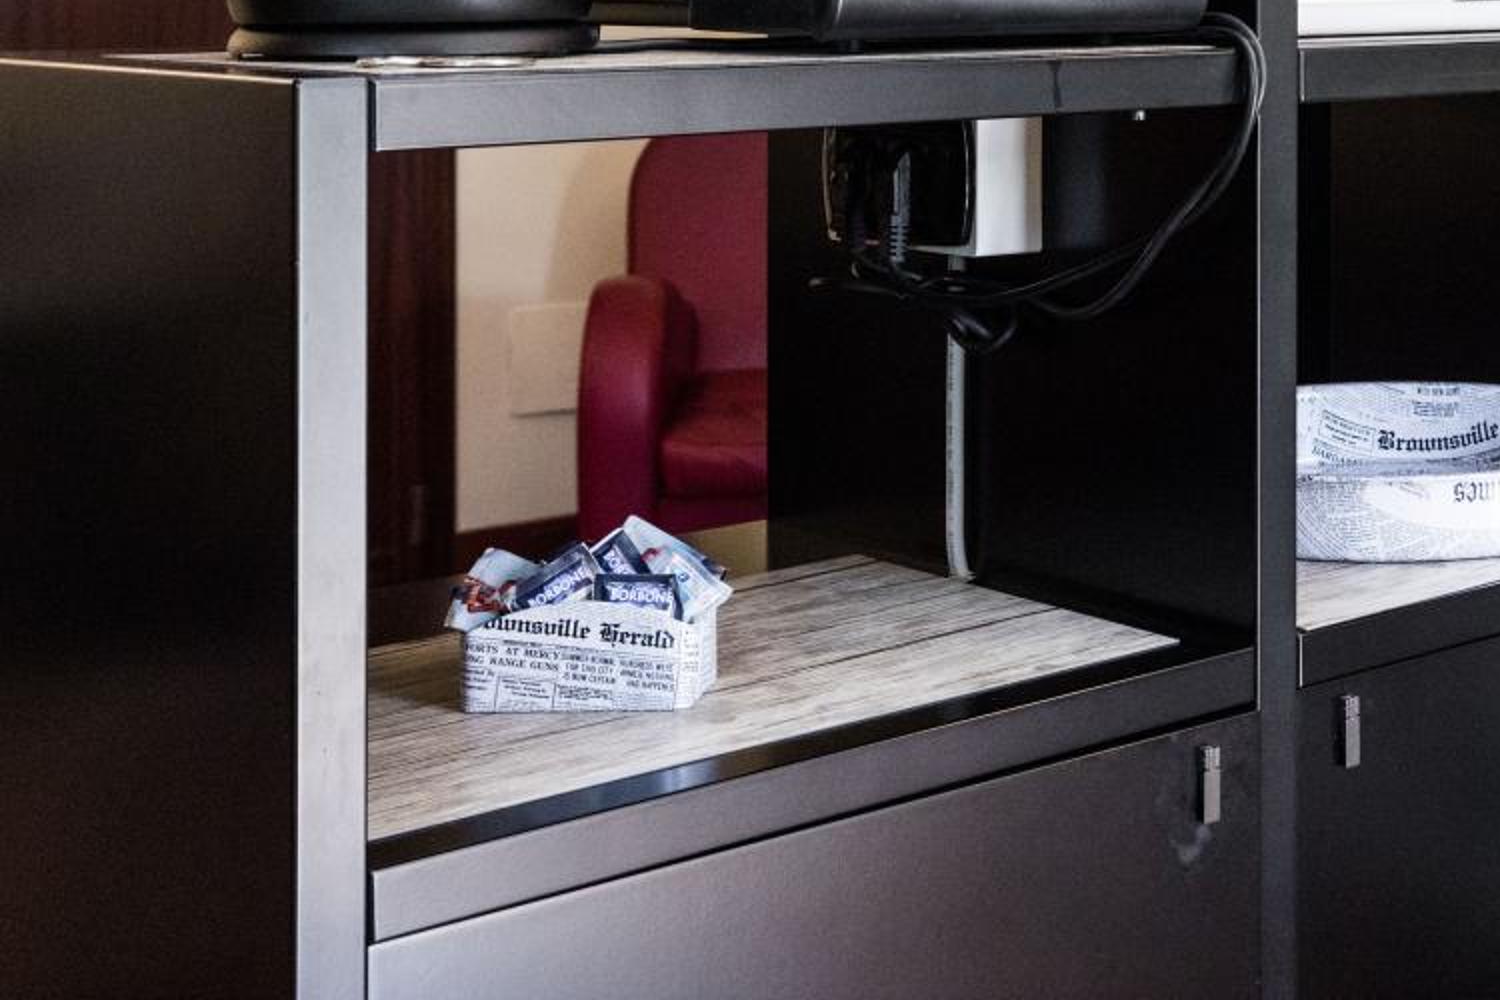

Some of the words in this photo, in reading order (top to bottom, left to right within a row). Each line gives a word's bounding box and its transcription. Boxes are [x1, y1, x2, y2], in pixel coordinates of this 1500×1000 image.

[1377, 420, 1499, 453] Brownsville
[482, 618, 591, 639] ownsville
[600, 622, 675, 649] Herald
